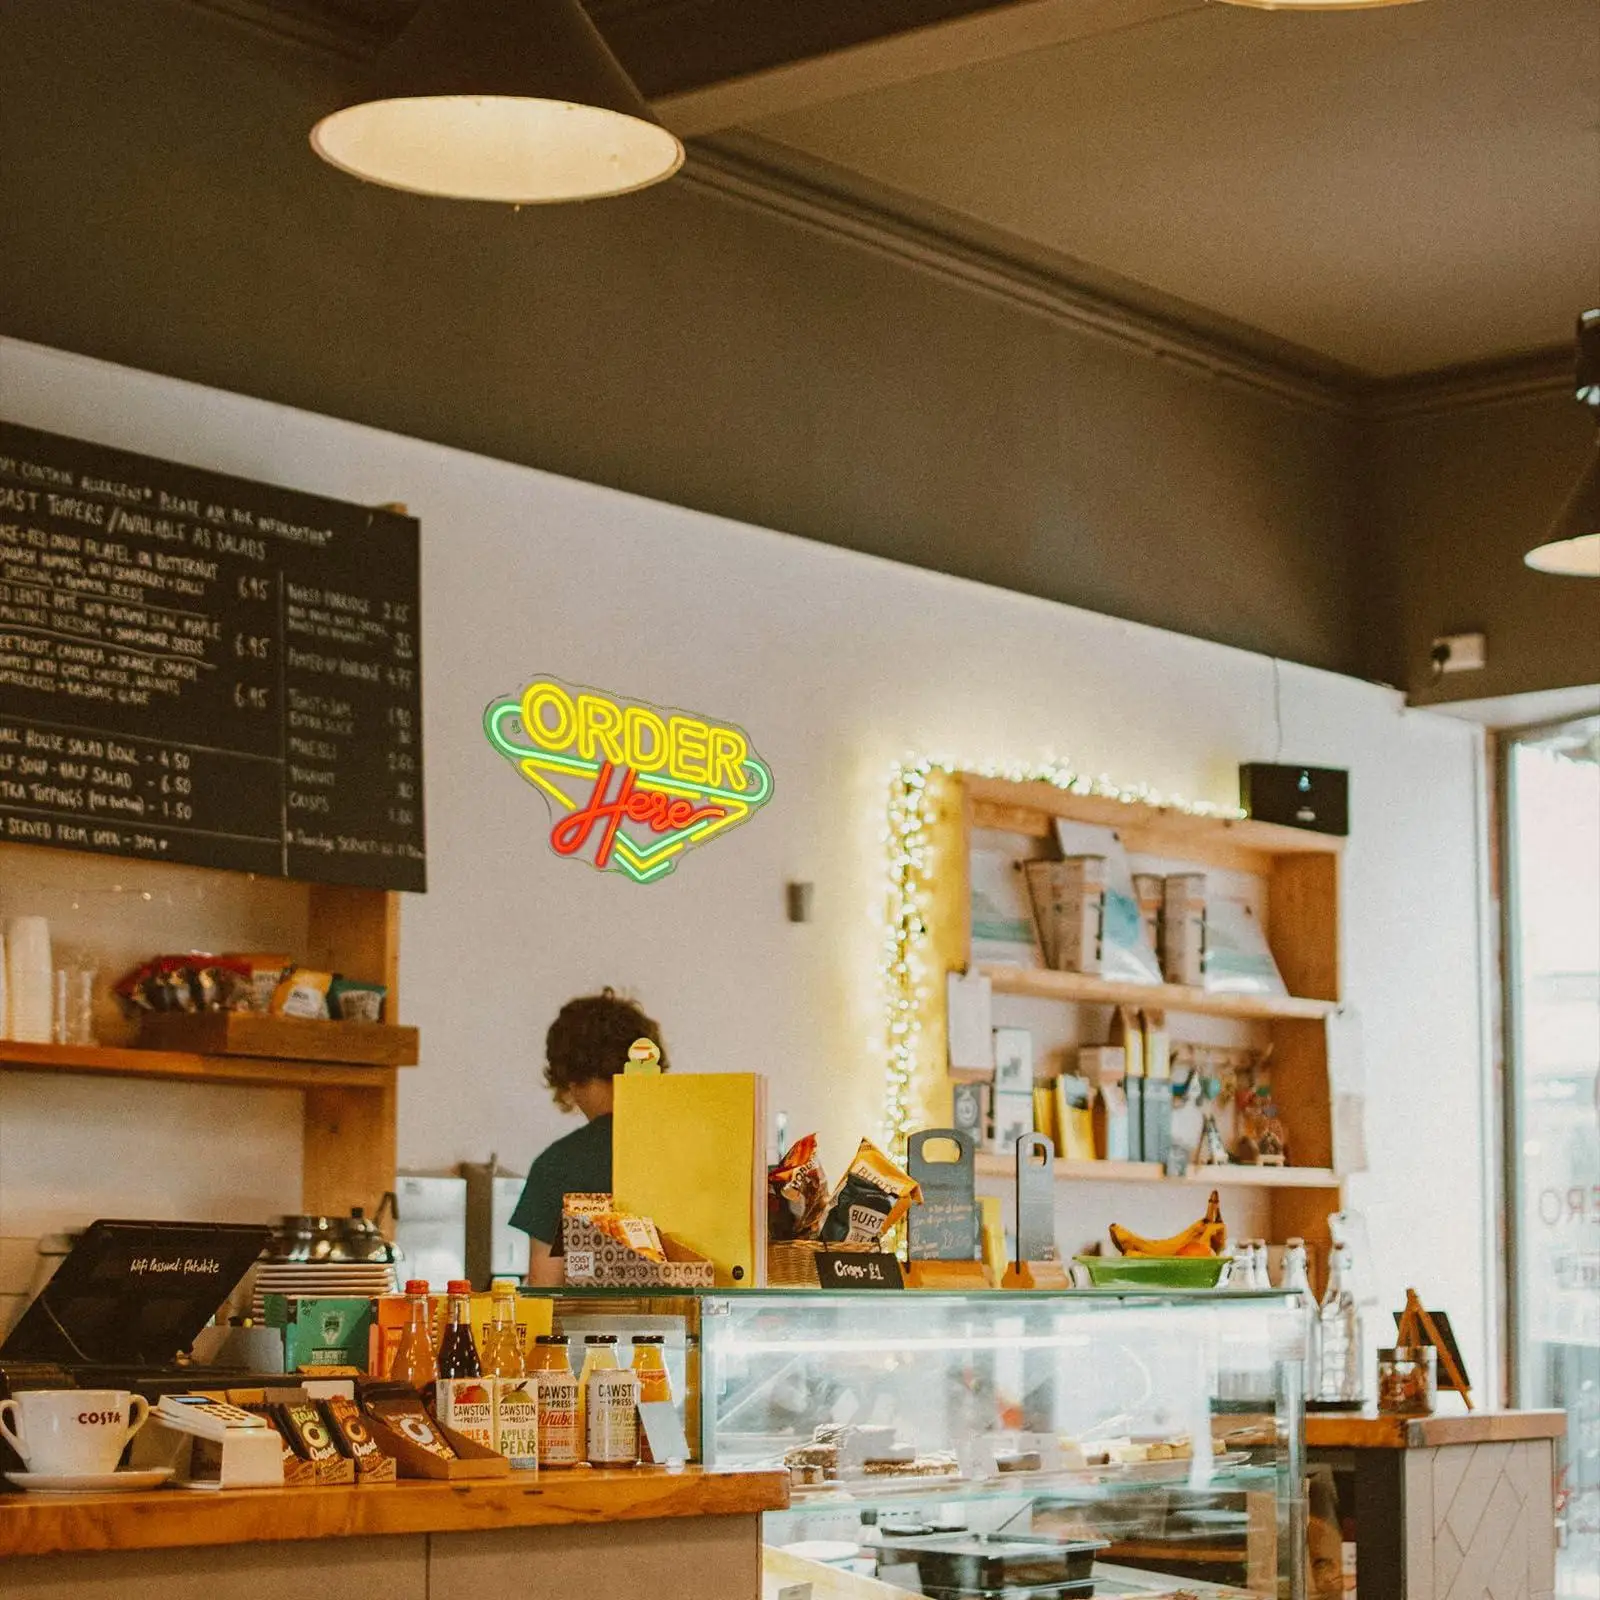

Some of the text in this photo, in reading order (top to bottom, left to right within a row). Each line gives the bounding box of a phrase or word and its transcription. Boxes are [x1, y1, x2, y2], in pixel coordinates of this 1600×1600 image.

[217, 531, 267, 561] SALADS
[26, 728, 64, 751] HOUSE
[68, 738, 104, 759] SALAD
[521, 681, 749, 792] ORDER
[18, 756, 48, 776] SOUP
[92, 766, 132, 790] SALAD
[550, 759, 727, 869] Here
[8, 816, 52, 840] SERVED
[569, 1255, 590, 1263] DOISY
[551, 1400, 572, 1408] PRESS
[612, 1398, 632, 1406] PRESS
[453, 1405, 490, 1417] CAWSTON
[500, 1404, 536, 1416] CAWSTON
[78, 1412, 122, 1426] COSTA
[501, 1429, 535, 1441] APPLE &
[501, 1441, 536, 1455] PEAR
